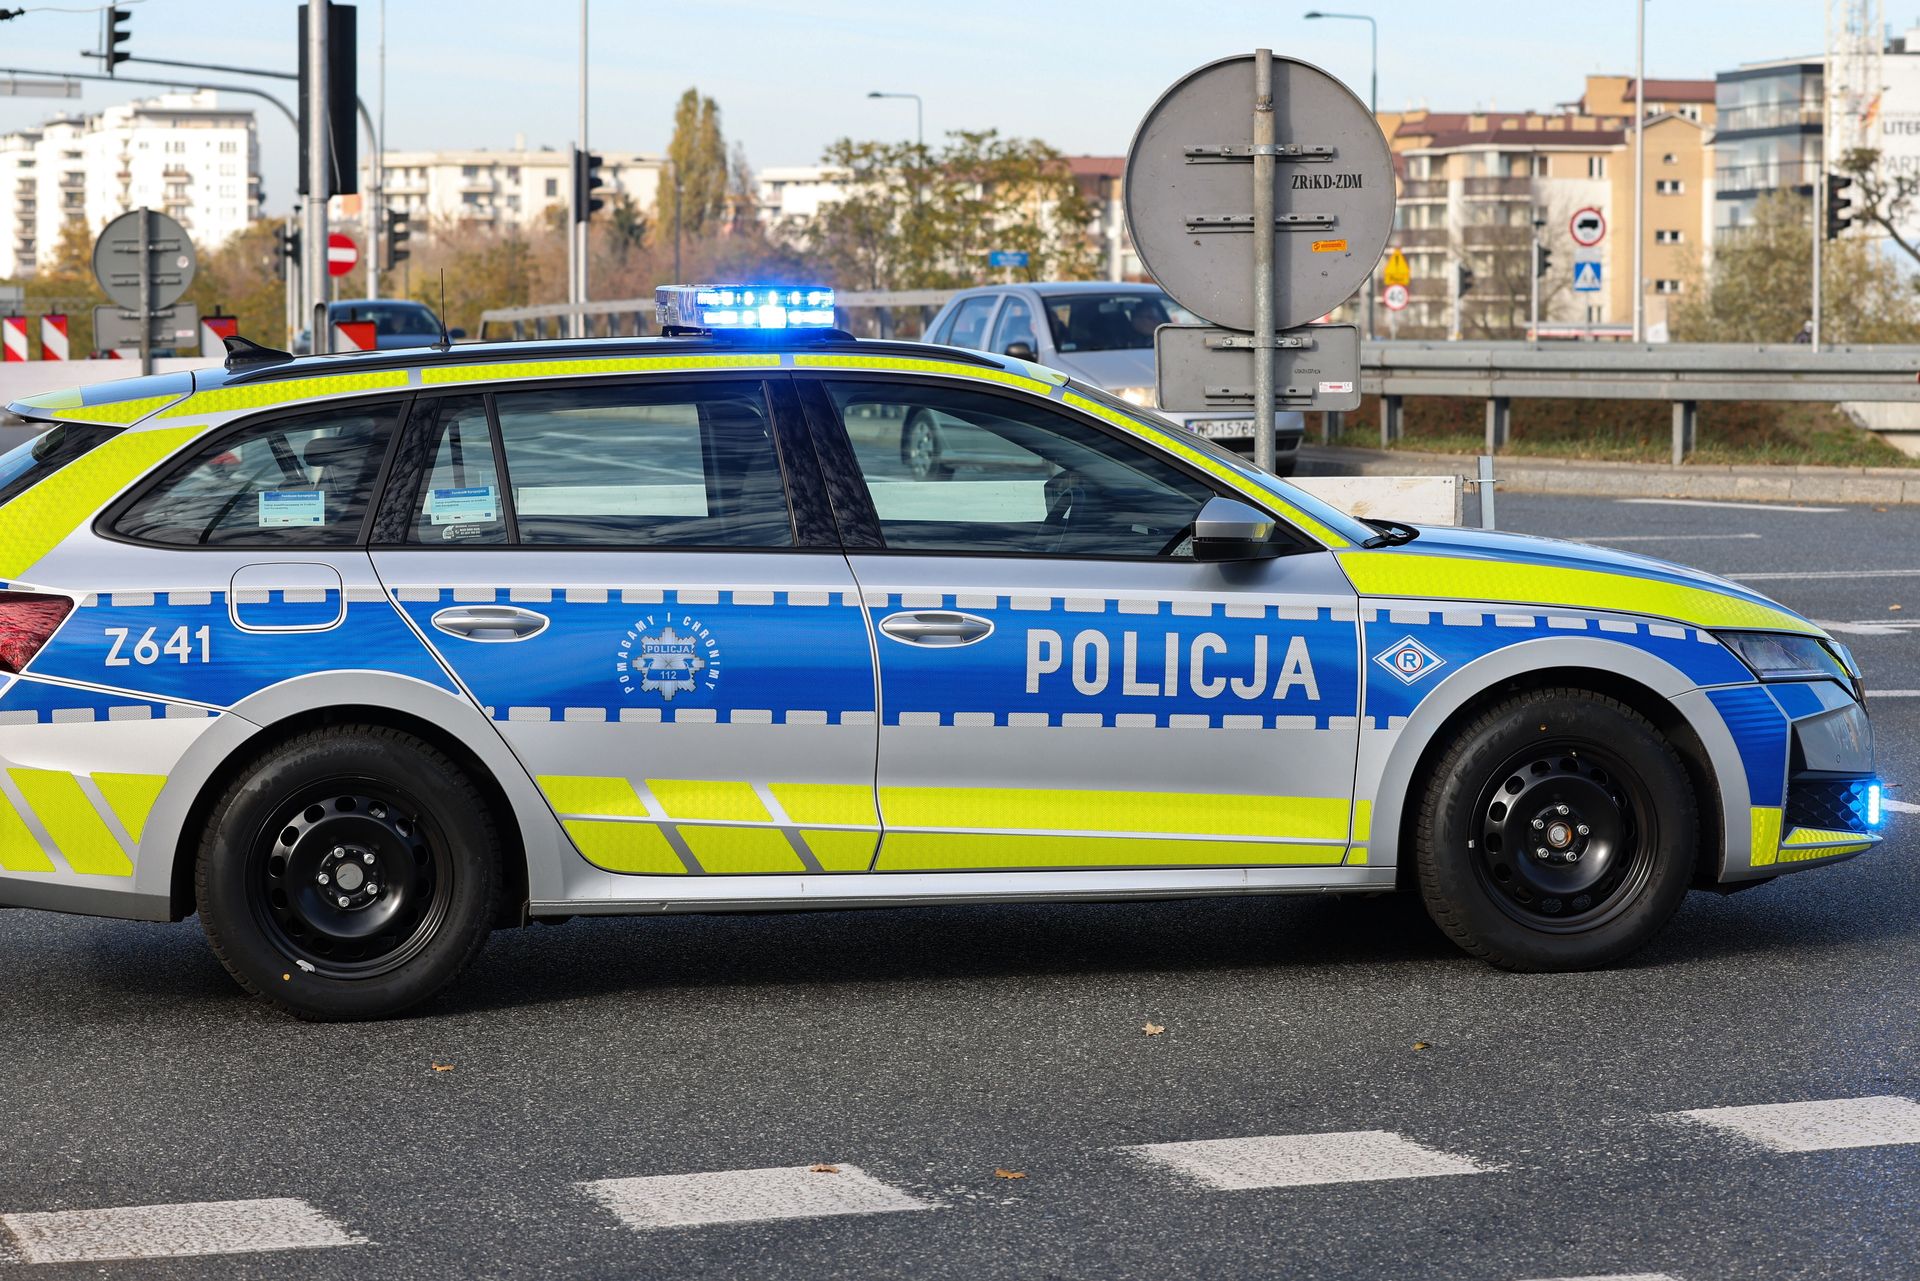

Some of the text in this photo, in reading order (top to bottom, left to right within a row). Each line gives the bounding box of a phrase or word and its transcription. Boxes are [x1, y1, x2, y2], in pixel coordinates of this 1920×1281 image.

[104, 625, 210, 666] Z641
[617, 612, 720, 694] POMAGAMY I CHRONIMY
[646, 645, 691, 653] POLICJA
[1025, 629, 1321, 701] POLICJA
[1403, 652, 1417, 668] R
[660, 671, 677, 680] 112
